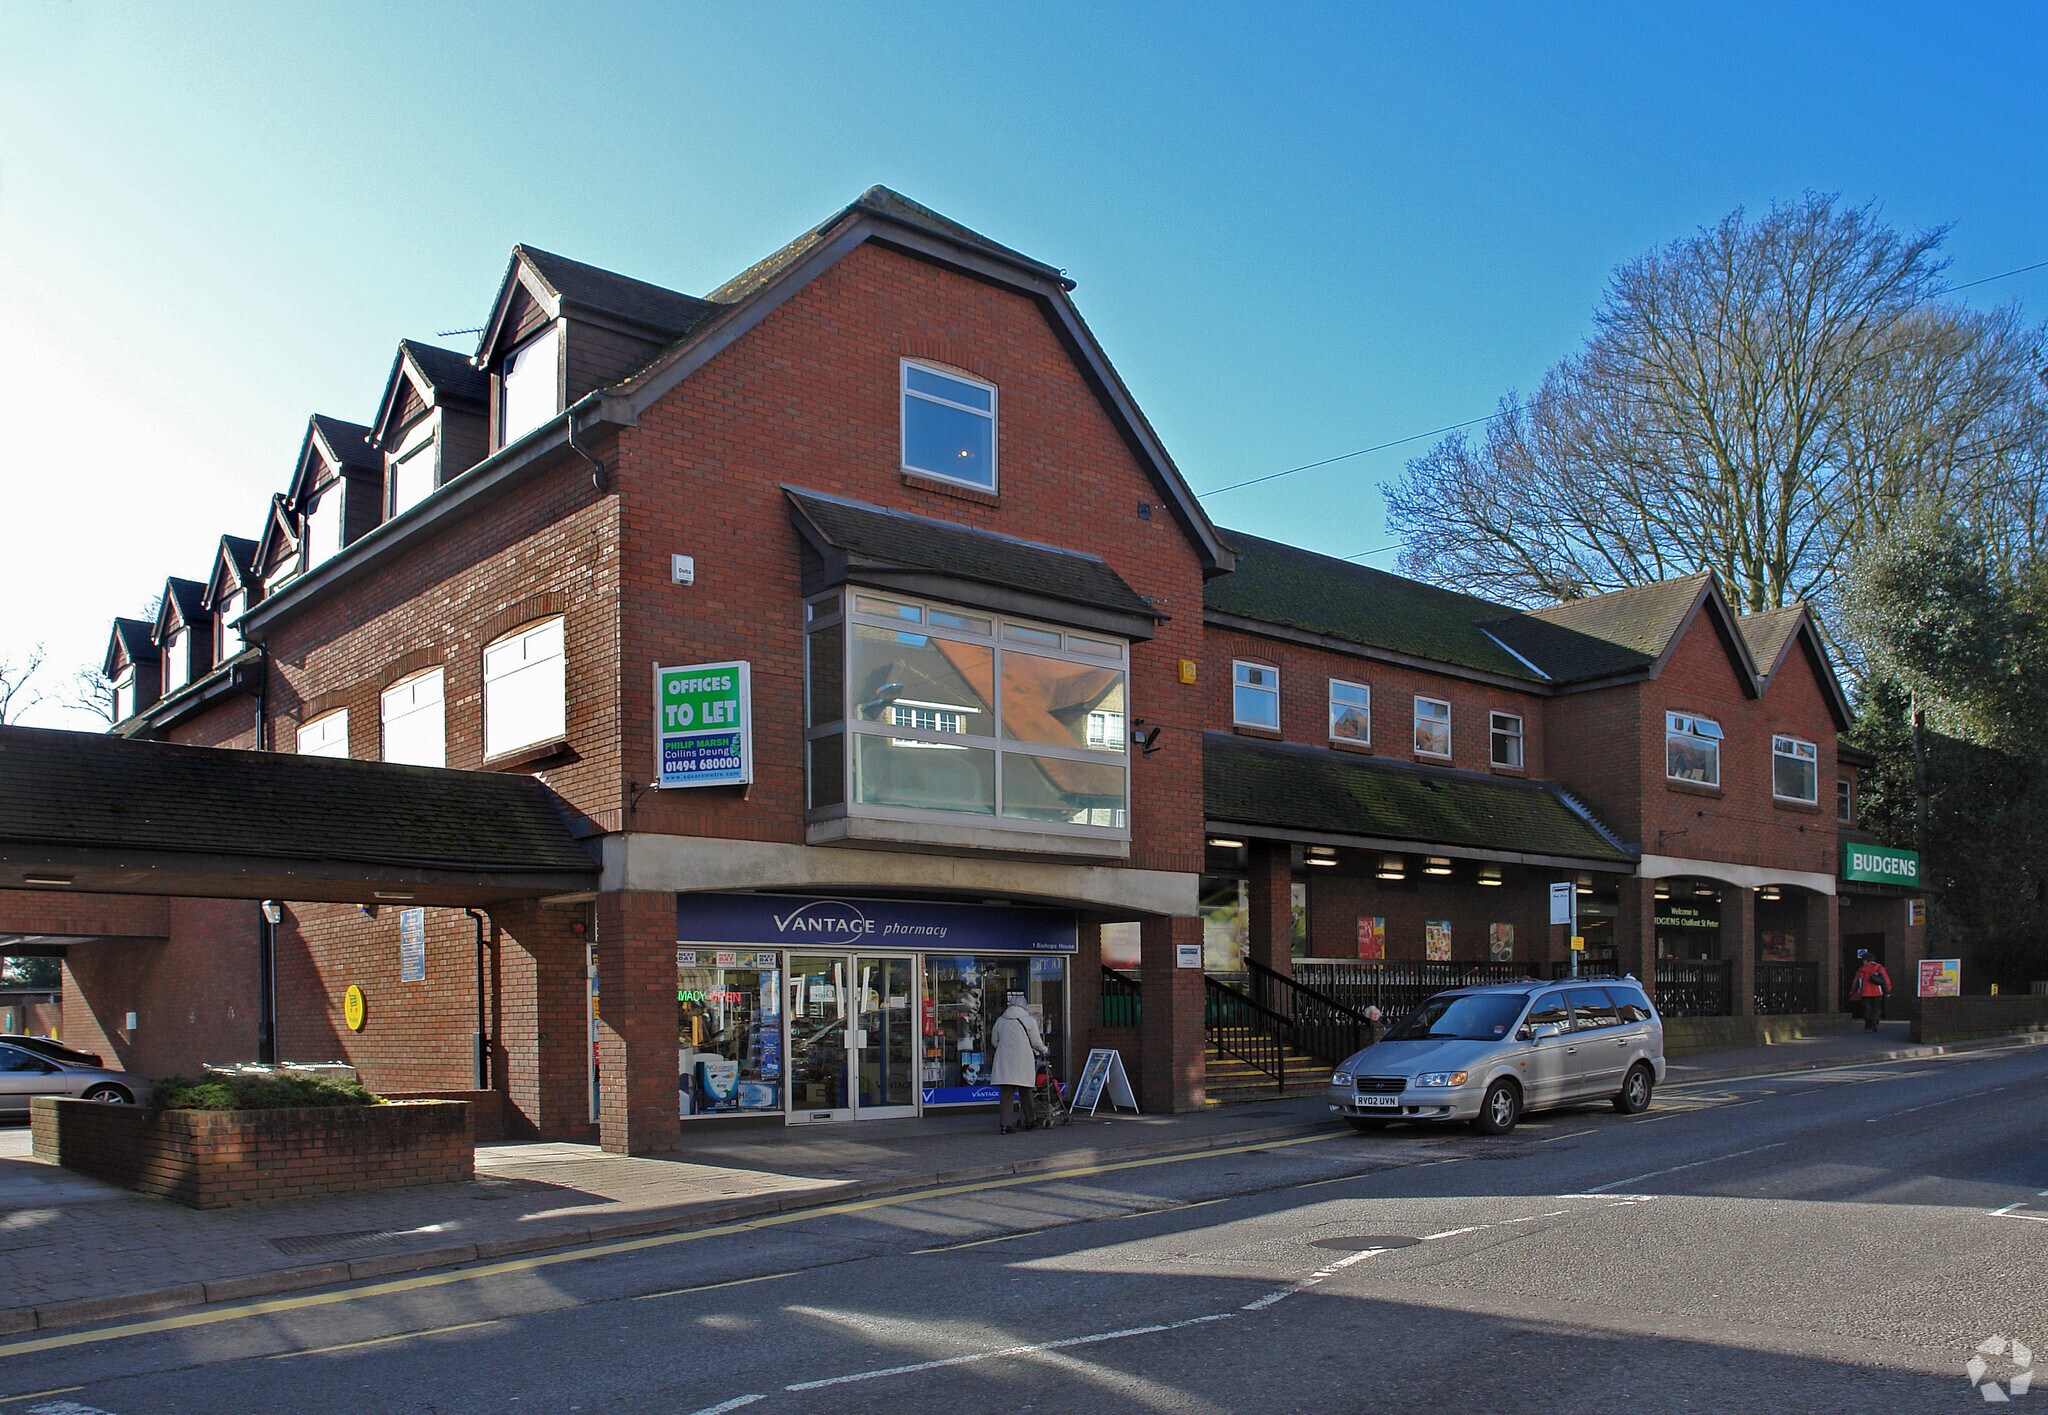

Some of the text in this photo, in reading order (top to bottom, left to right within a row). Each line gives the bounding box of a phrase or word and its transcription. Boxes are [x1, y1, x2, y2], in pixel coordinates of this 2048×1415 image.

[669, 675, 731, 695] OFFICES
[665, 700, 737, 726] TO LET
[665, 738, 729, 750] PHILIP MARSH
[665, 750, 697, 759] Collins
[665, 757, 740, 772] 01494 680000
[1853, 853, 1917, 877] BUDGENS
[1671, 907, 1692, 915] Welcome
[773, 914, 948, 938] VANTAGE pharmacy
[709, 990, 741, 1003] OPEN
[1358, 1096, 1378, 1104] RV02
